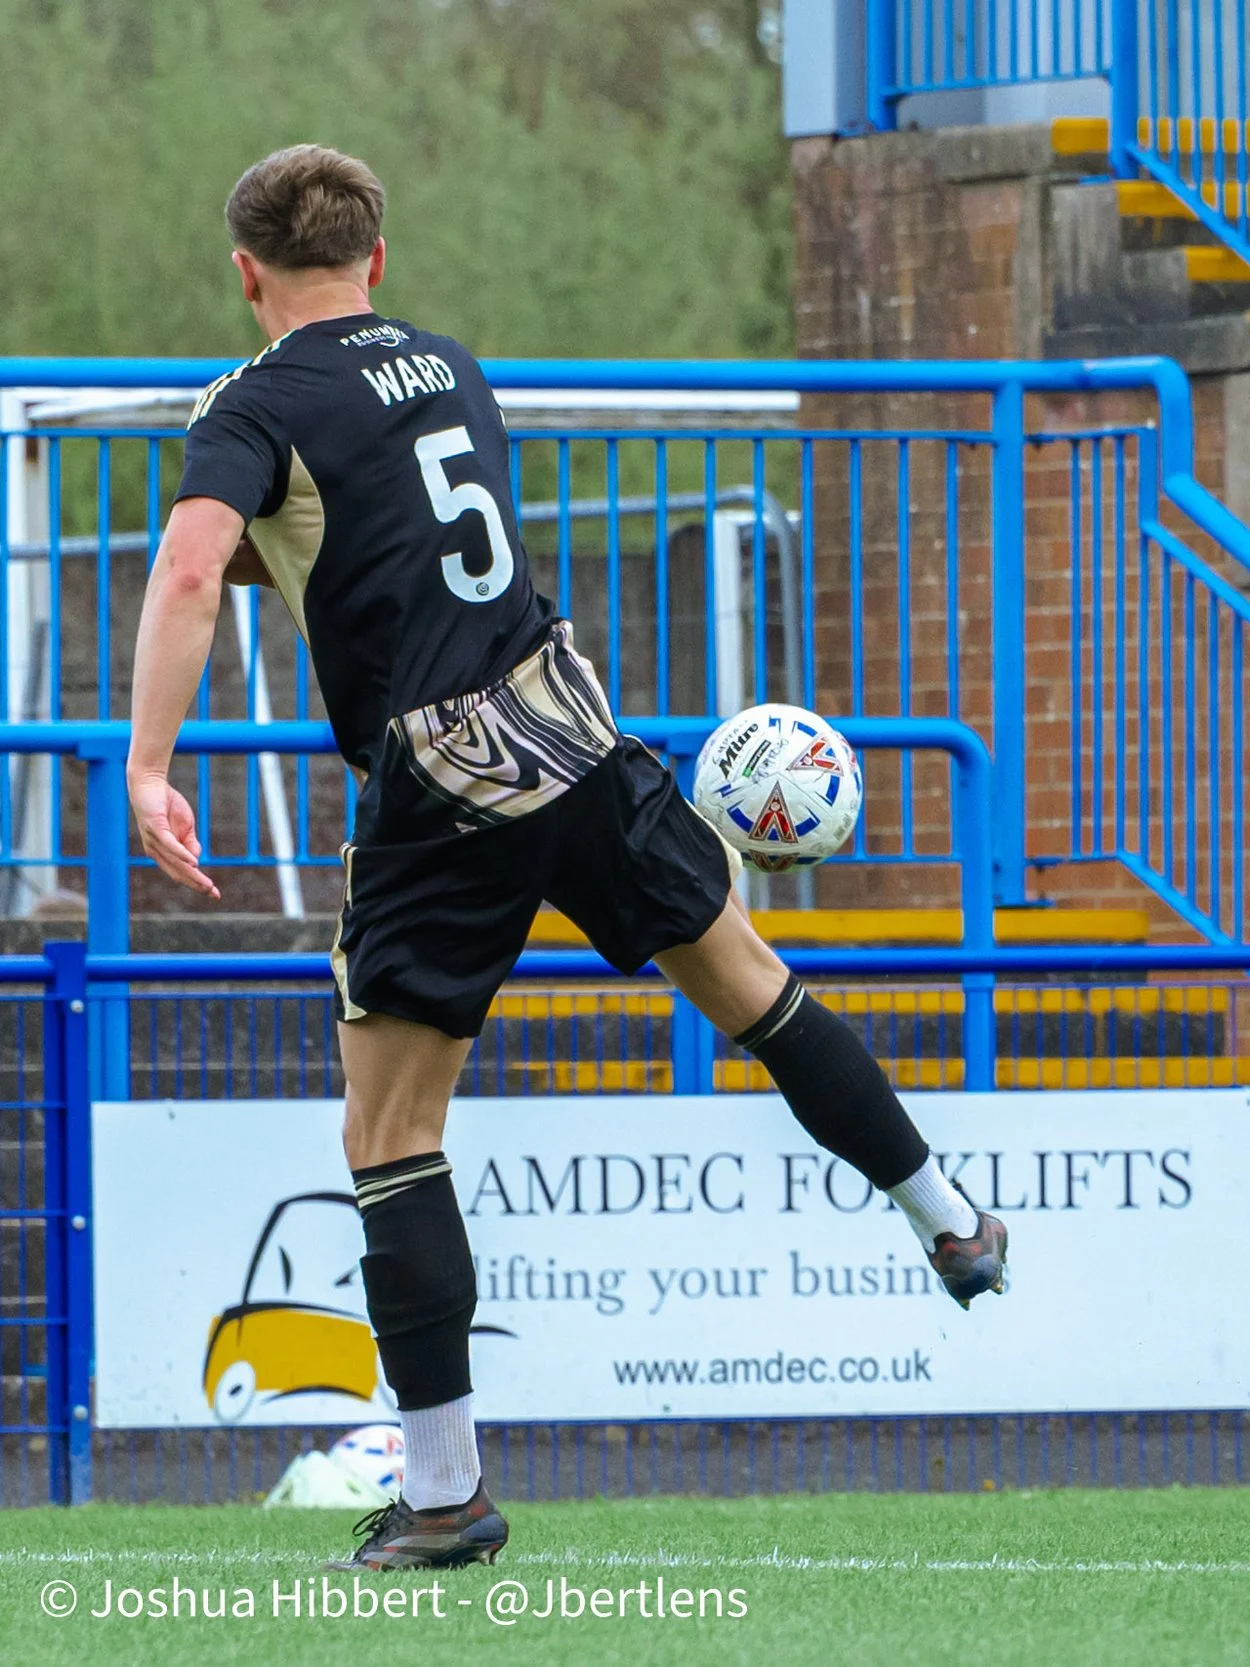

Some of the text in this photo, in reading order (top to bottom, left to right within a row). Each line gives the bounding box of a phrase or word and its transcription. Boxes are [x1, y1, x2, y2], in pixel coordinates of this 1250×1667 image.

[360, 354, 456, 406] WARD
[413, 424, 514, 603] 5
[466, 1148, 1193, 1217] AMDEC FOKLIFTS
[649, 1265, 768, 1316] your
[790, 1251, 1011, 1299] busin
[613, 1348, 933, 1387] www.amdec.co.uk
